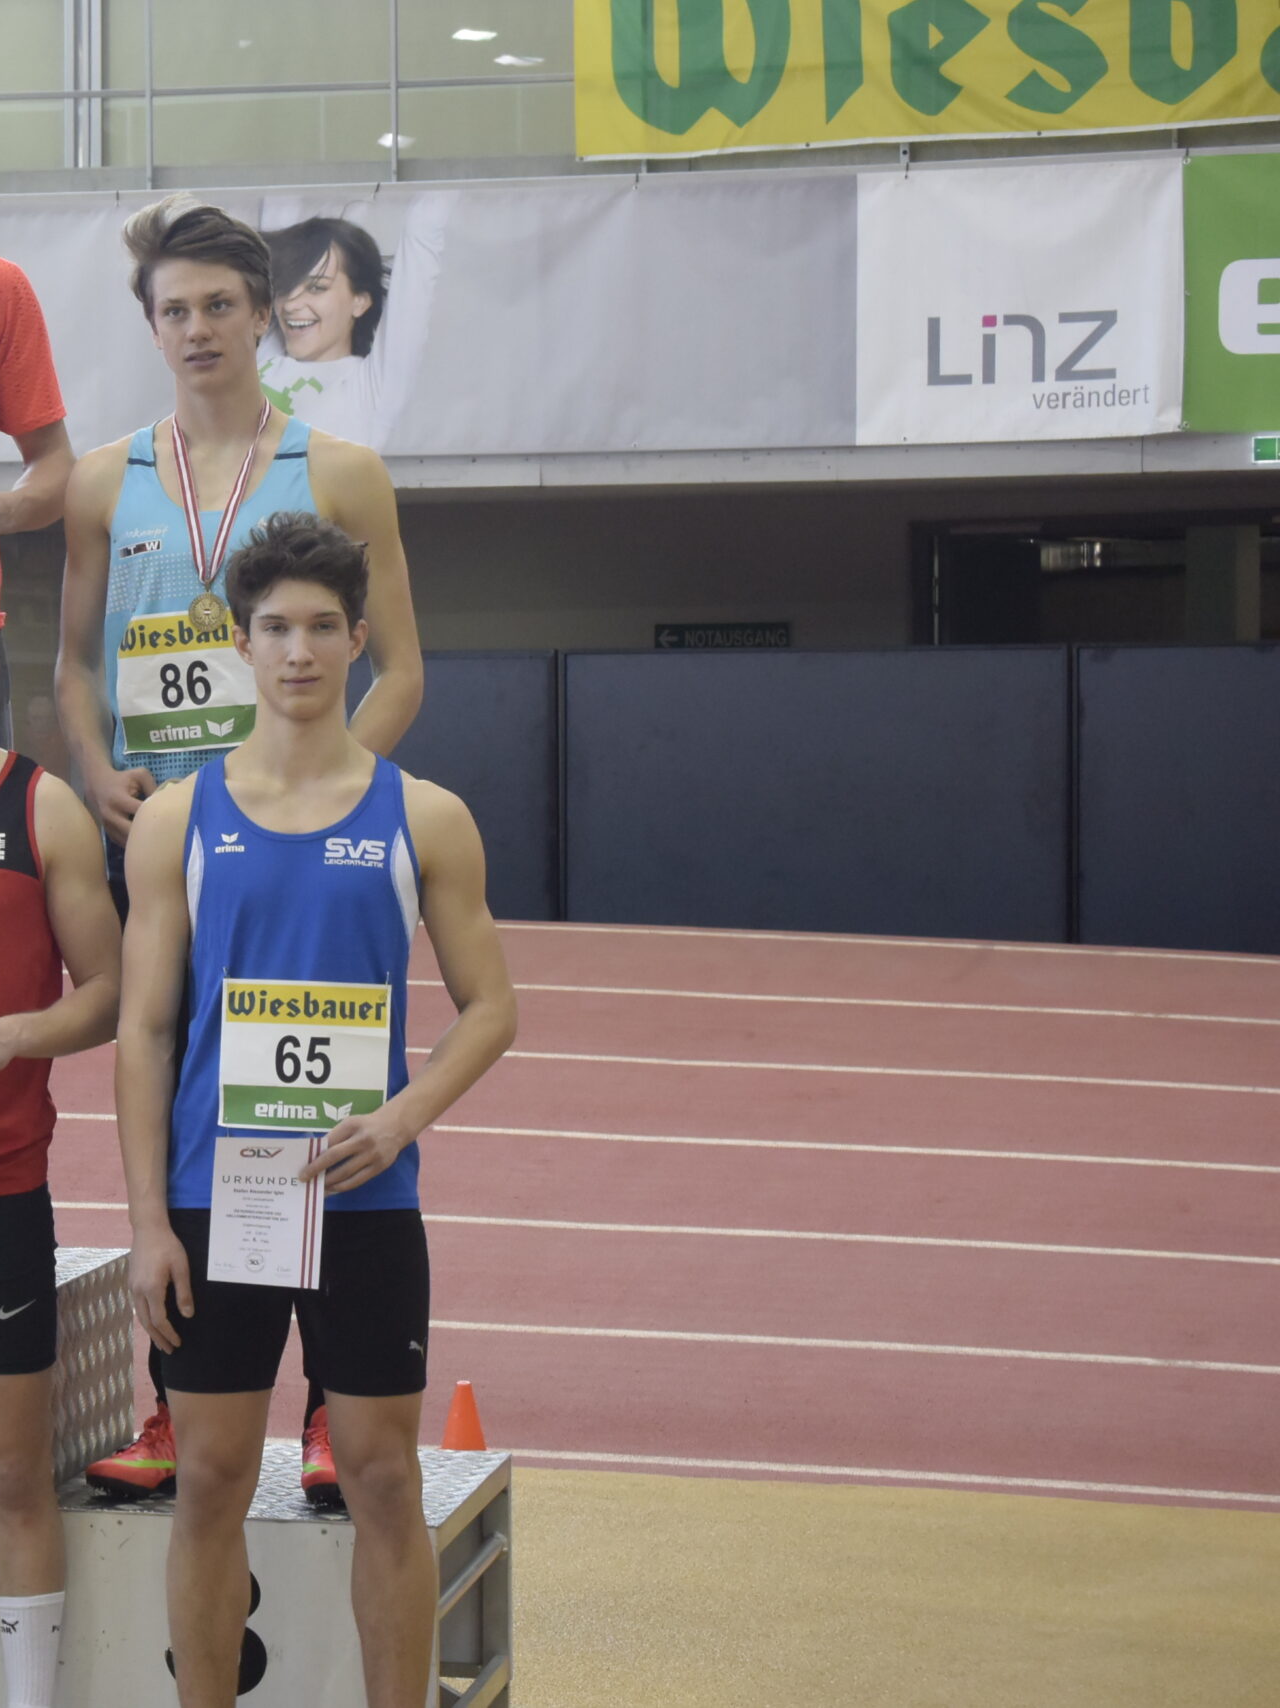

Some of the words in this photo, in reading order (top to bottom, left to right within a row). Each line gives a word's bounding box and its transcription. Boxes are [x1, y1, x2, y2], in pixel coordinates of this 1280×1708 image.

[611, 0, 1280, 136] Wiesb
[1032, 382, 1150, 410] verändert
[685, 629, 787, 647] NOTAUSGANG
[159, 660, 212, 708] 86
[149, 724, 203, 743] erima
[215, 844, 245, 853] erima
[324, 837, 386, 861] SVS
[226, 990, 387, 1021] Wiesbauer
[274, 1034, 332, 1085] 65
[254, 1101, 318, 1120] erima
[221, 1174, 299, 1187] URKUNDE
